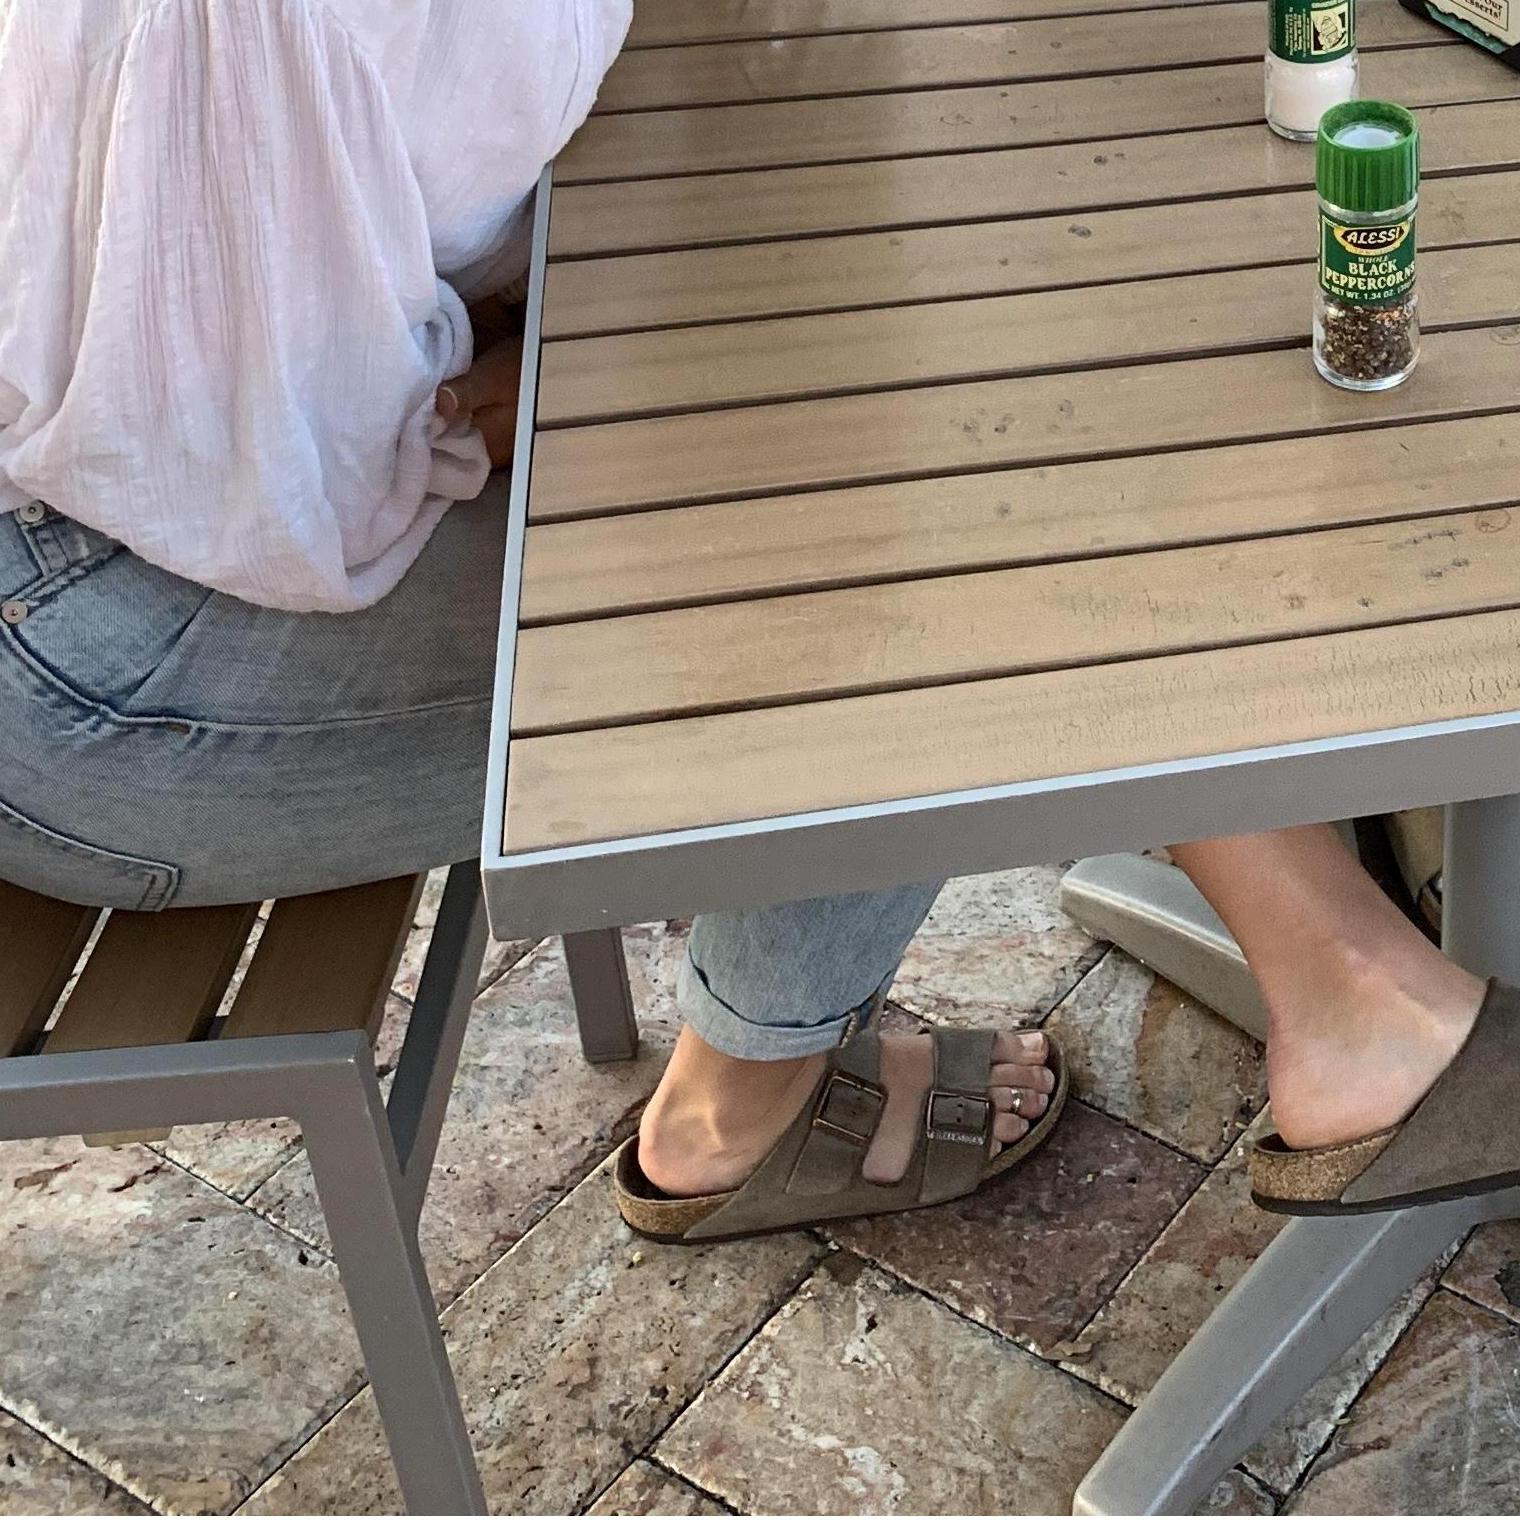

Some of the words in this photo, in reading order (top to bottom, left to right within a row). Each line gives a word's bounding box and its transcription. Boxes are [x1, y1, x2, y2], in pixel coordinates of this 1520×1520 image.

[1346, 226, 1400, 244] ALESSI
[1325, 260, 1415, 290] PEPPERCORNS
[1348, 259, 1398, 276] BLACK
[1331, 285, 1345, 296] NET
[1364, 292, 1381, 300] 1.34
